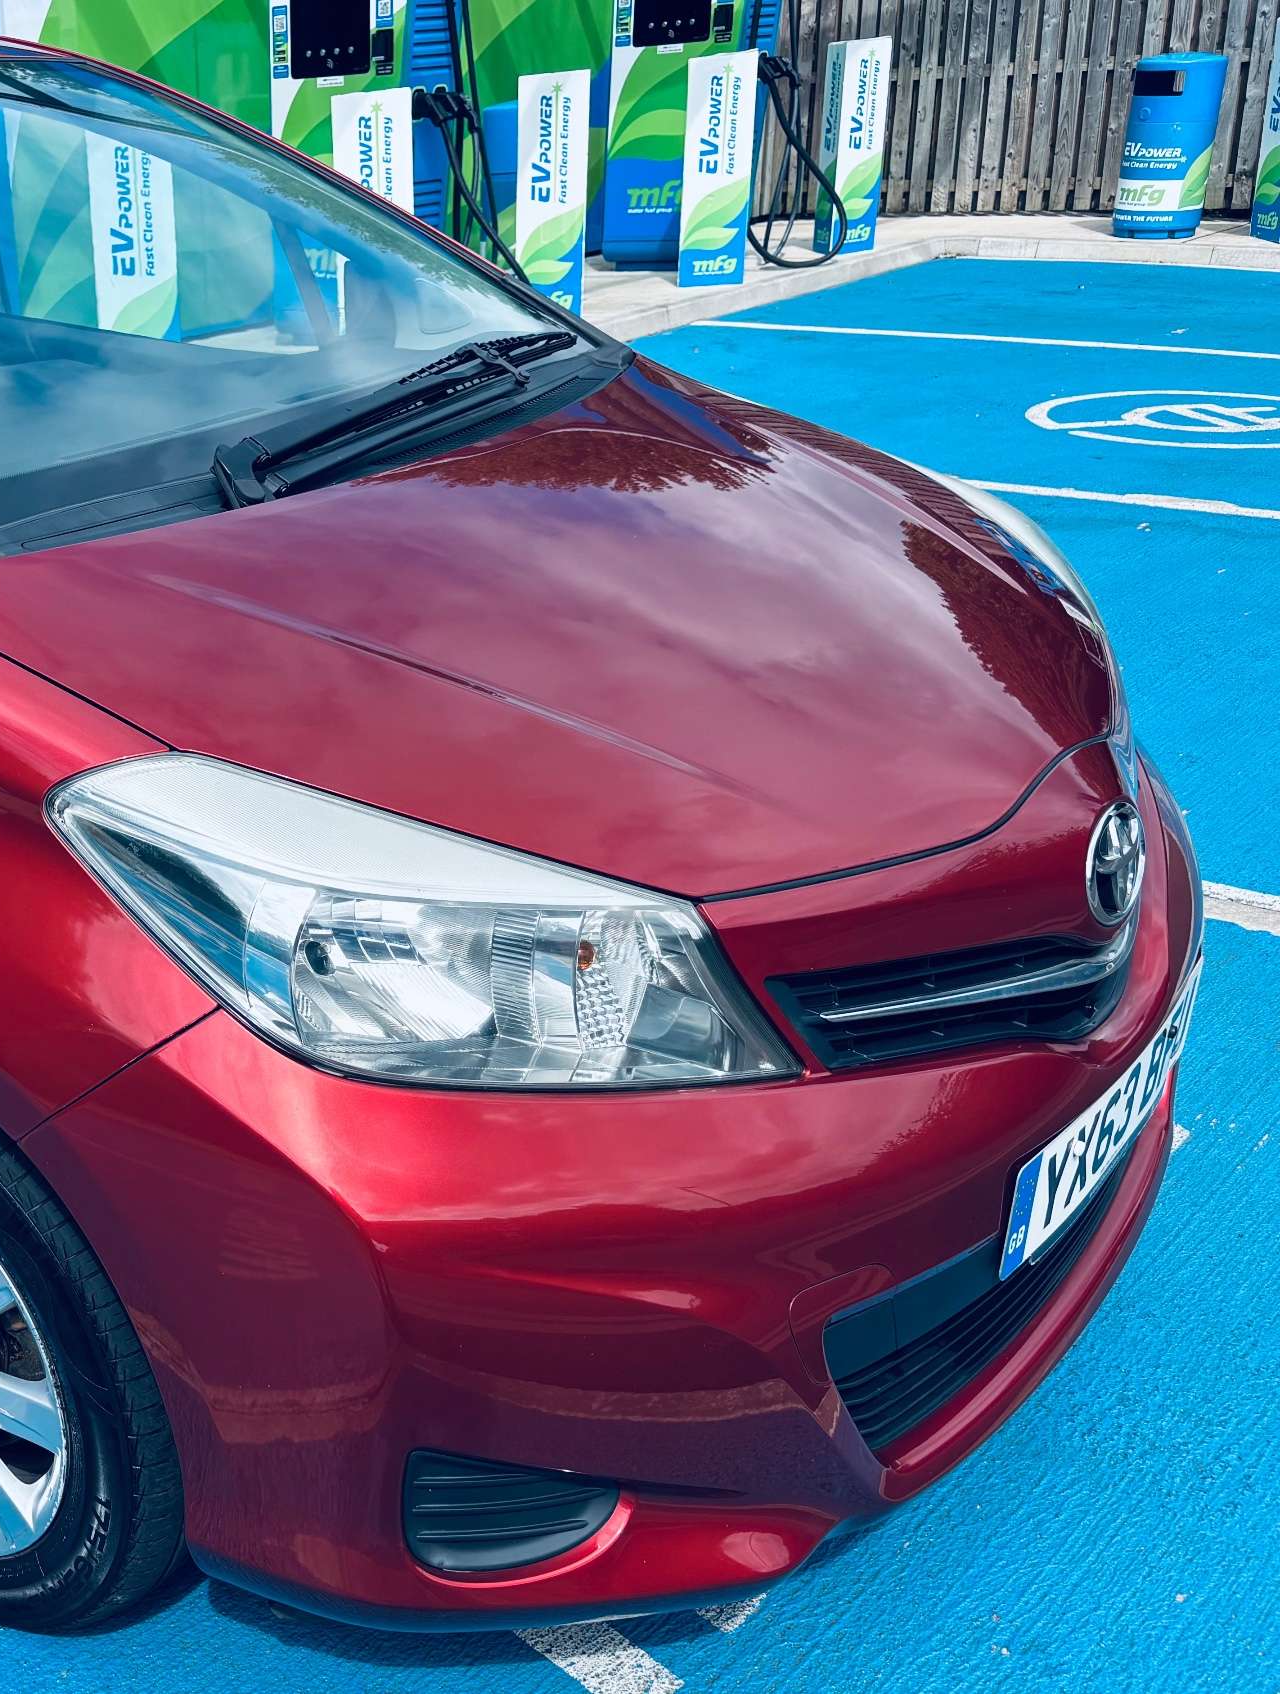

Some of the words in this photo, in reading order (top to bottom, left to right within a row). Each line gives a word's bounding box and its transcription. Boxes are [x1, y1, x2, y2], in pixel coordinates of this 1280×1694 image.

[872, 59, 881, 96] Energy
[730, 76, 741, 116] Energy
[560, 96, 571, 139] Energy
[382, 117, 393, 163] Energy
[727, 118, 737, 150] Clean
[559, 141, 568, 175] Clean
[726, 153, 735, 175] Fast
[1150, 162, 1178, 170] Energy
[384, 167, 393, 200] lean
[558, 177, 567, 204] Fast
[627, 179, 681, 208] mf
[1120, 184, 1165, 206] mfg
[143, 202, 153, 243] Clean
[1257, 212, 1279, 230] mfg
[145, 247, 155, 277] Fast
[692, 255, 738, 274] mfg
[547, 290, 574, 310] fg
[1043, 1062, 1141, 1229] YX63
[1008, 1224, 1026, 1255] GB
